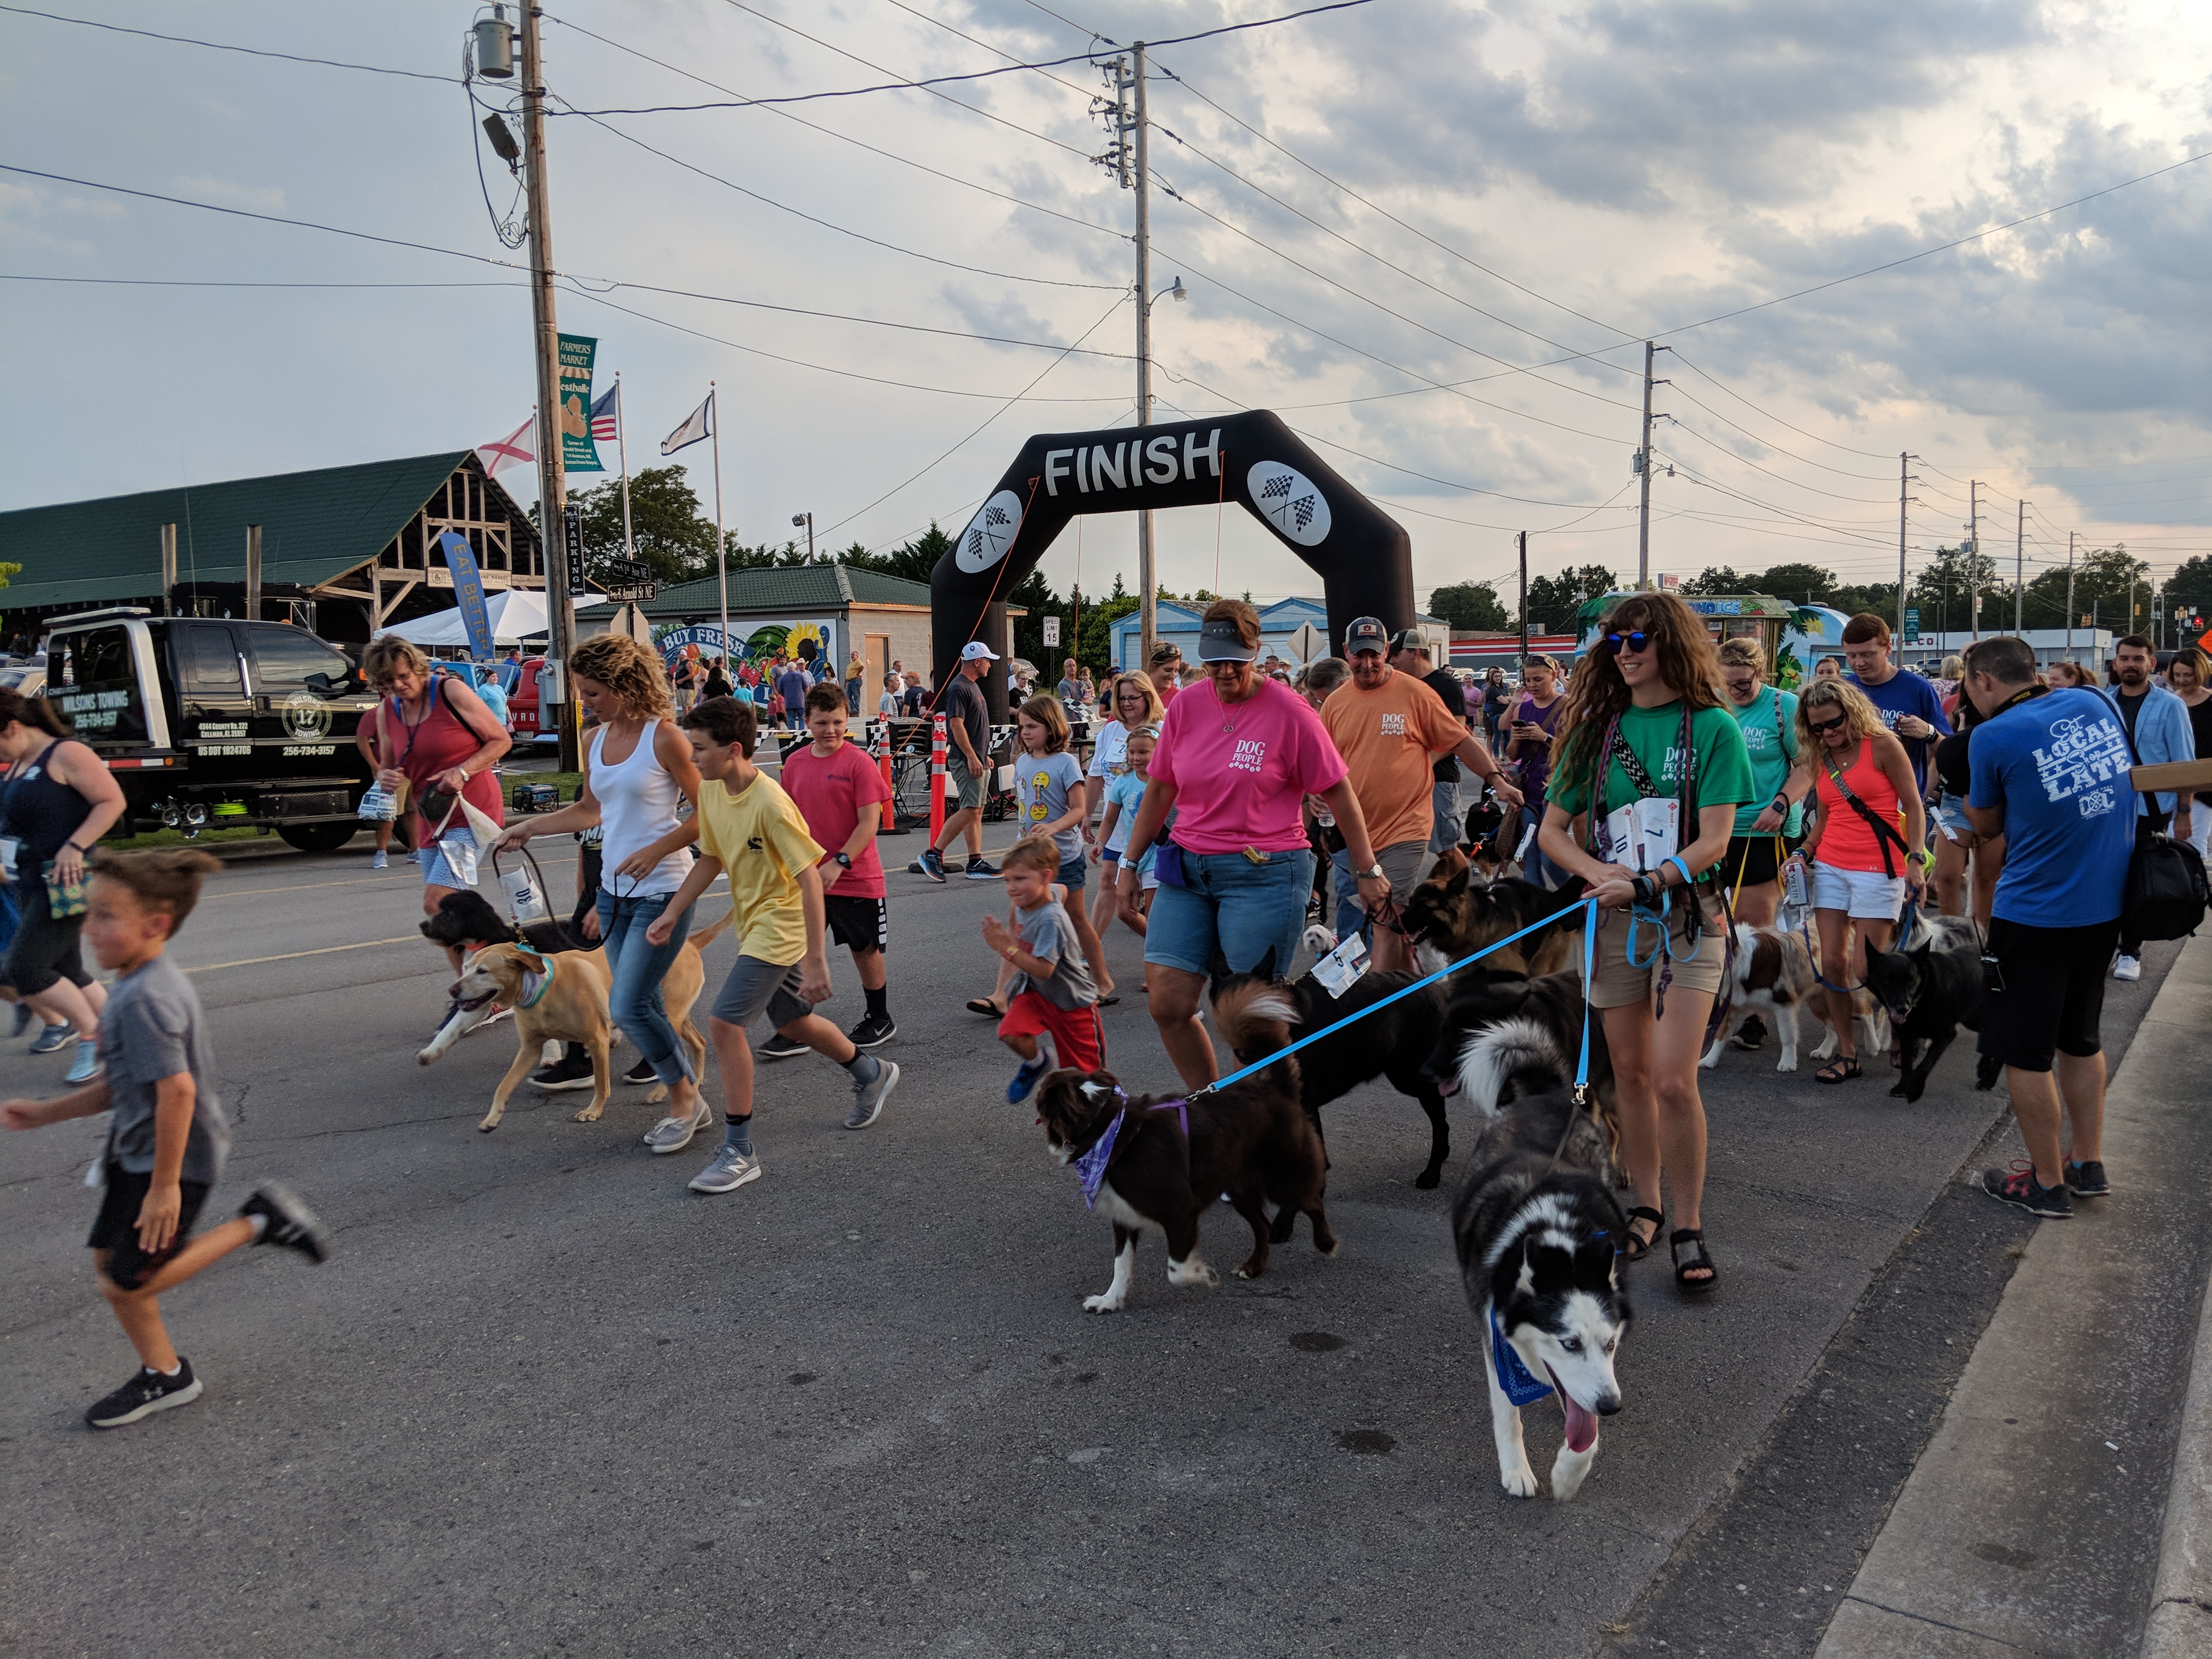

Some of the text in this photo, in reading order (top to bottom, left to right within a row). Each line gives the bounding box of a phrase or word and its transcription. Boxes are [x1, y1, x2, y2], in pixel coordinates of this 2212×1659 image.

[560, 341, 591, 354] FARMERS
[560, 353, 588, 365] MARKET
[560, 381, 590, 393] esthalle
[1045, 428, 1221, 496] FINISH
[569, 522, 580, 583] PARKING
[631, 566, 640, 577] Ave
[640, 567, 648, 579] NE
[453, 544, 473, 577] EAT
[463, 583, 490, 652] BETTER
[622, 585, 653, 600] Arnold St NE
[1688, 601, 1741, 614] NA ICE
[663, 629, 745, 657] BUY FRESH
[1047, 633, 1057, 642] 15
[63, 689, 129, 713] WILSONS TOWING
[291, 695, 323, 708] WILSONS
[297, 709, 317, 725] 17
[1382, 714, 1405, 724] DOG
[295, 728, 321, 738] TOWING
[1743, 726, 1767, 739] DOG
[2050, 715, 2085, 743] Eat
[1118, 744, 1128, 754] 2
[1235, 740, 1266, 757] DOG
[2032, 718, 2117, 767] LOCAL
[198, 745, 251, 756] US DOT 1824706
[283, 745, 336, 756] 256-734-3157
[1232, 753, 1263, 766] PEOPLE
[2066, 749, 2102, 775] Shop
[1662, 762, 1697, 774] PEPE
[2042, 749, 2132, 803] LATE
[1645, 829, 1663, 838] 7
[1615, 834, 1628, 854] 10
[1790, 873, 1798, 899] ULTRA
[515, 887, 533, 904] 30
[1332, 951, 1344, 967] 5
